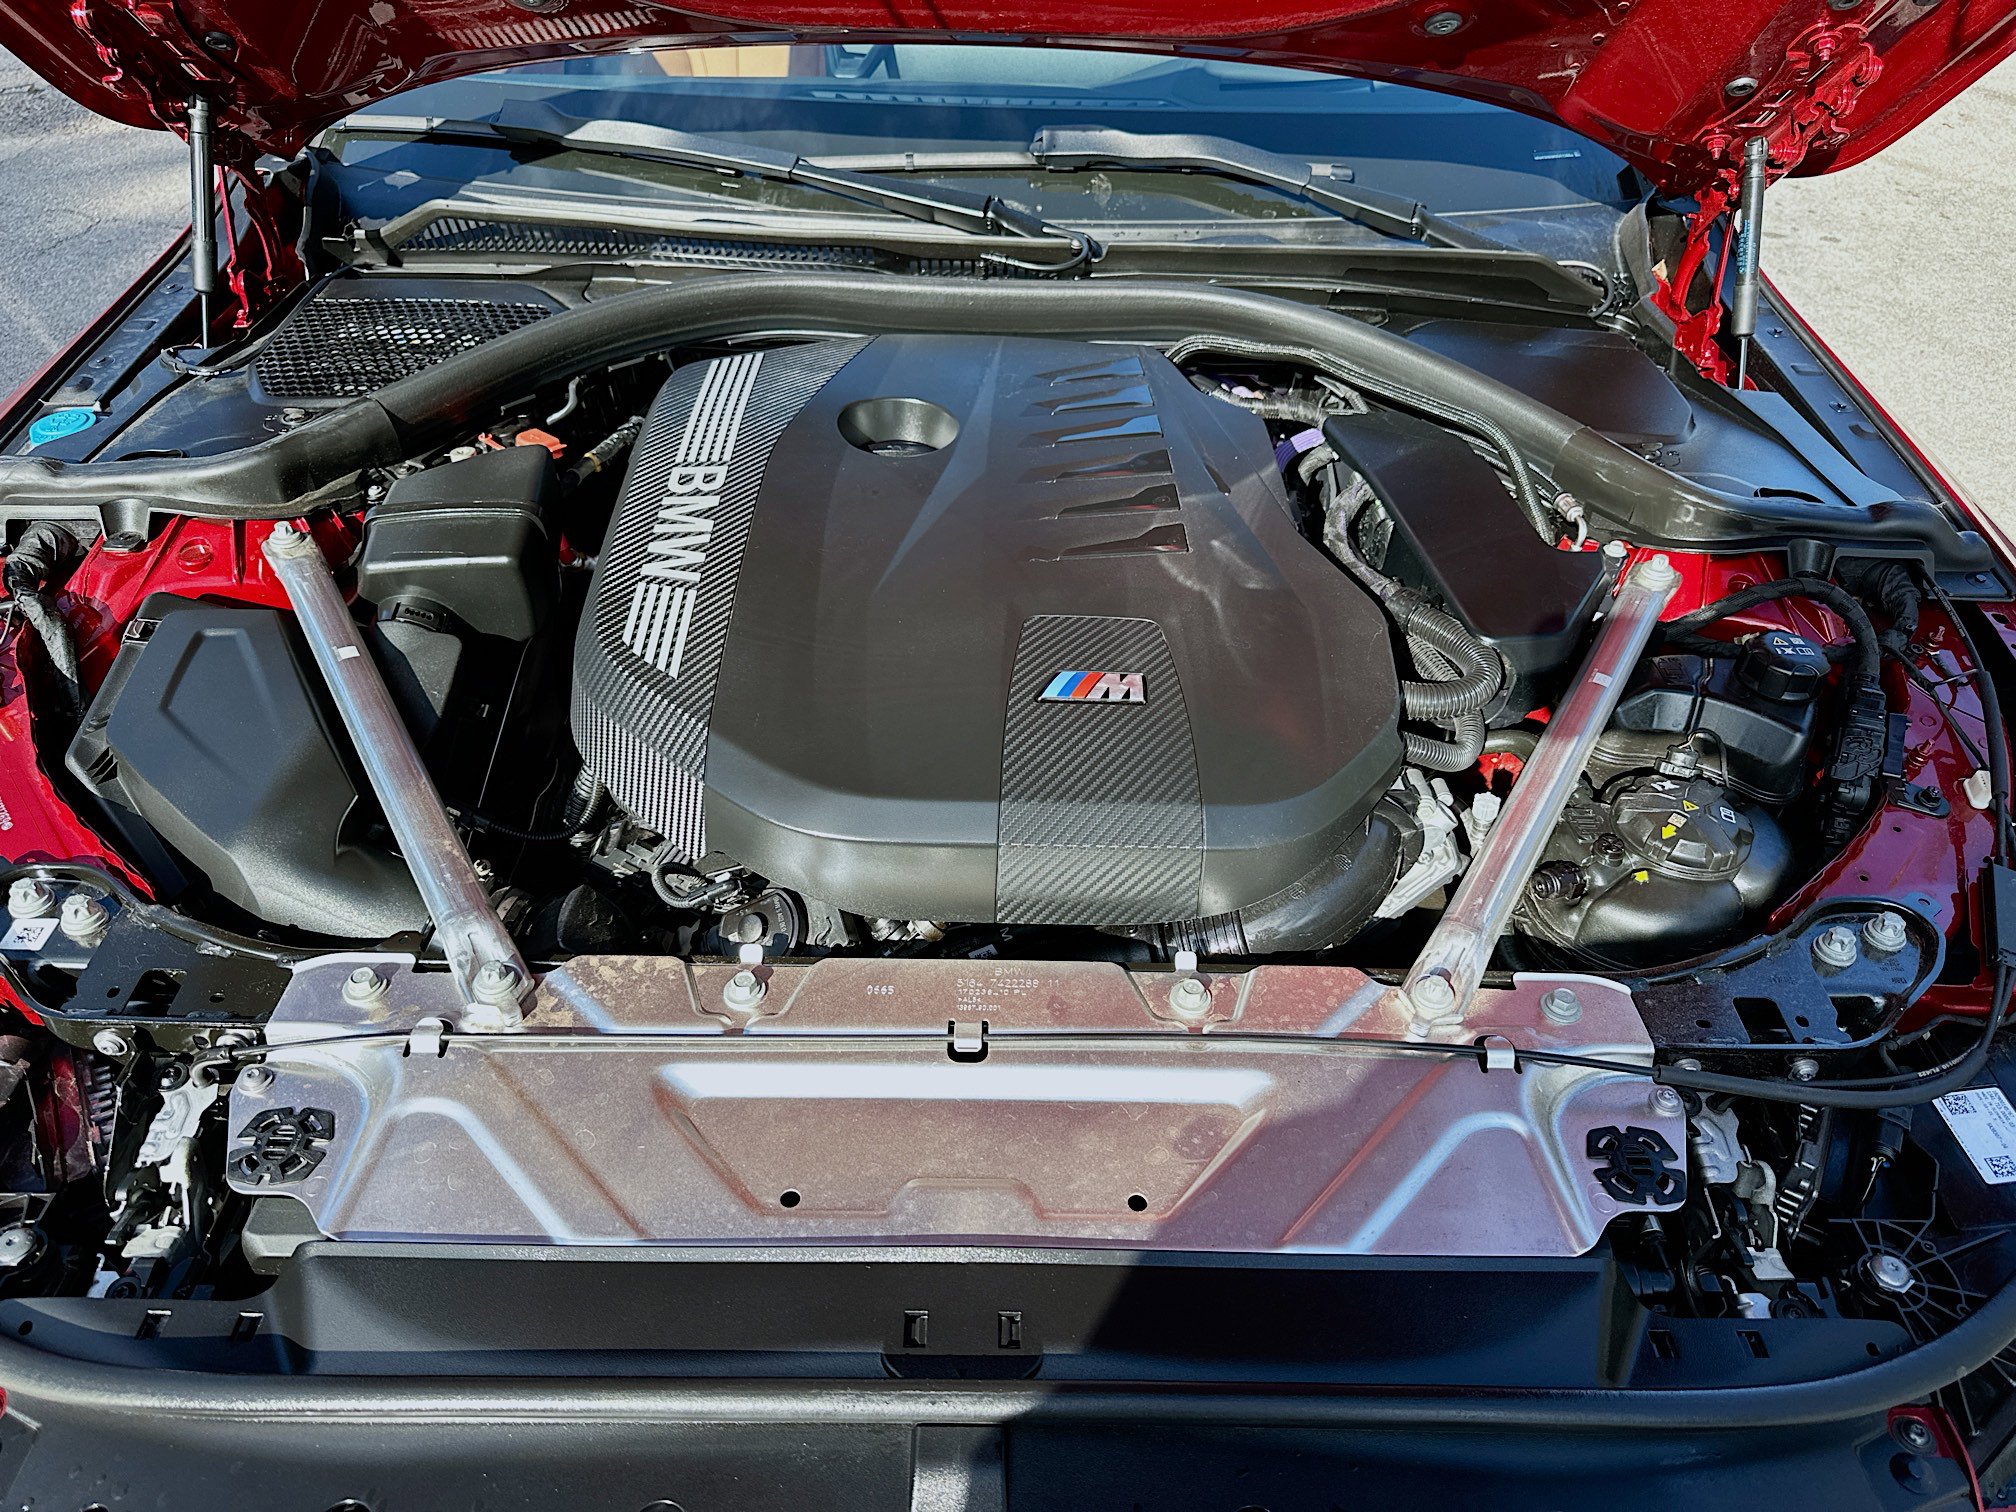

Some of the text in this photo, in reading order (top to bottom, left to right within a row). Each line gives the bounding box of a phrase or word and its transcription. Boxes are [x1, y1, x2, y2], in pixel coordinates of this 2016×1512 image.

[640, 465, 727, 582] BMW
[1083, 672, 1146, 703] M
[993, 966, 1024, 976] BMW
